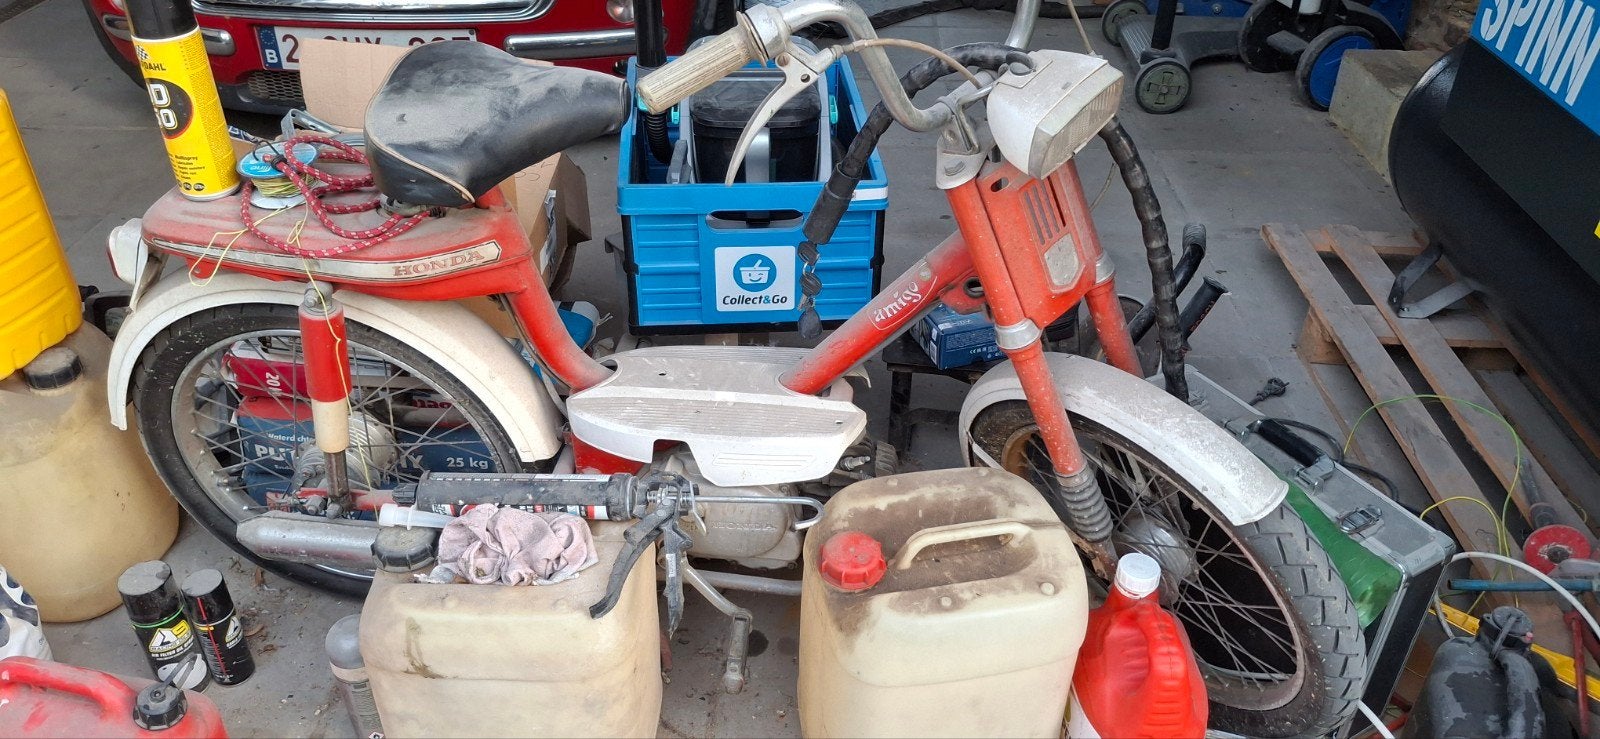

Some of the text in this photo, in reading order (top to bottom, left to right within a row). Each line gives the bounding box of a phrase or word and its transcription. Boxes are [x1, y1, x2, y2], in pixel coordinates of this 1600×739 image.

[264, 49, 278, 63] B
[142, 61, 167, 71] DAHL
[392, 250, 485, 276] HONDA
[722, 294, 788, 306] Collect&Go
[446, 457, 488, 470] 25 kg
